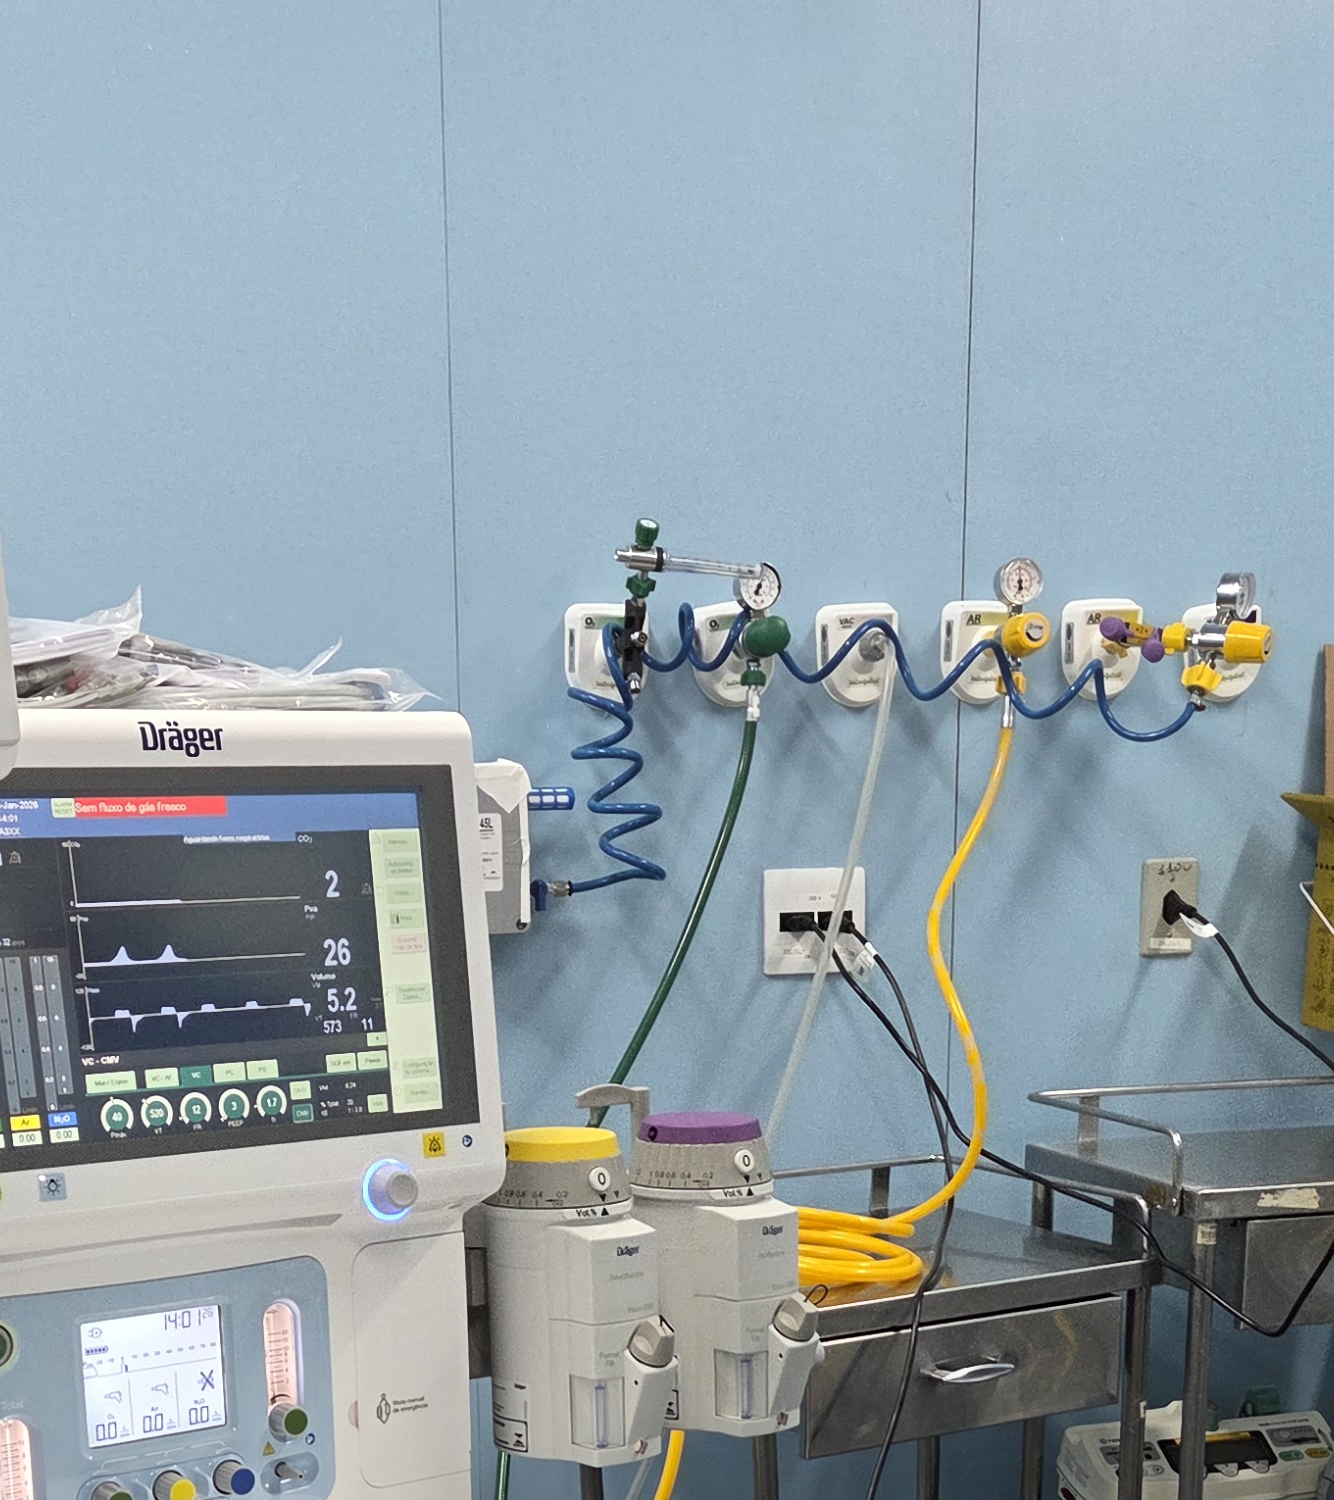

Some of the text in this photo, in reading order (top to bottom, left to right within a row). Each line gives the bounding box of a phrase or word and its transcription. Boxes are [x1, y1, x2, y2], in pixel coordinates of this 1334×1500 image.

[838, 617, 855, 626] VAC
[967, 614, 982, 625] AR
[1087, 612, 1101, 623] AR
[138, 721, 224, 758] Dräger
[75, 801, 99, 814] Sem
[99, 801, 123, 813] fluxo
[124, 801, 138, 813] de
[156, 800, 188, 812] fresco
[324, 869, 341, 899] 2
[323, 937, 351, 967] 26
[327, 986, 357, 1013] 5.2
[323, 1019, 343, 1033] 573
[361, 1017, 374, 1031] 11
[81, 1057, 95, 1067] VC
[191, 1105, 201, 1115] 12
[231, 1101, 238, 1111] 3
[111, 1112, 123, 1122] 40
[19, 1133, 36, 1143] 0.00
[55, 1129, 73, 1139] 0.00
[742, 1154, 751, 1168] 0
[597, 1172, 606, 1186] 0
[164, 1309, 202, 1331] 14:01
